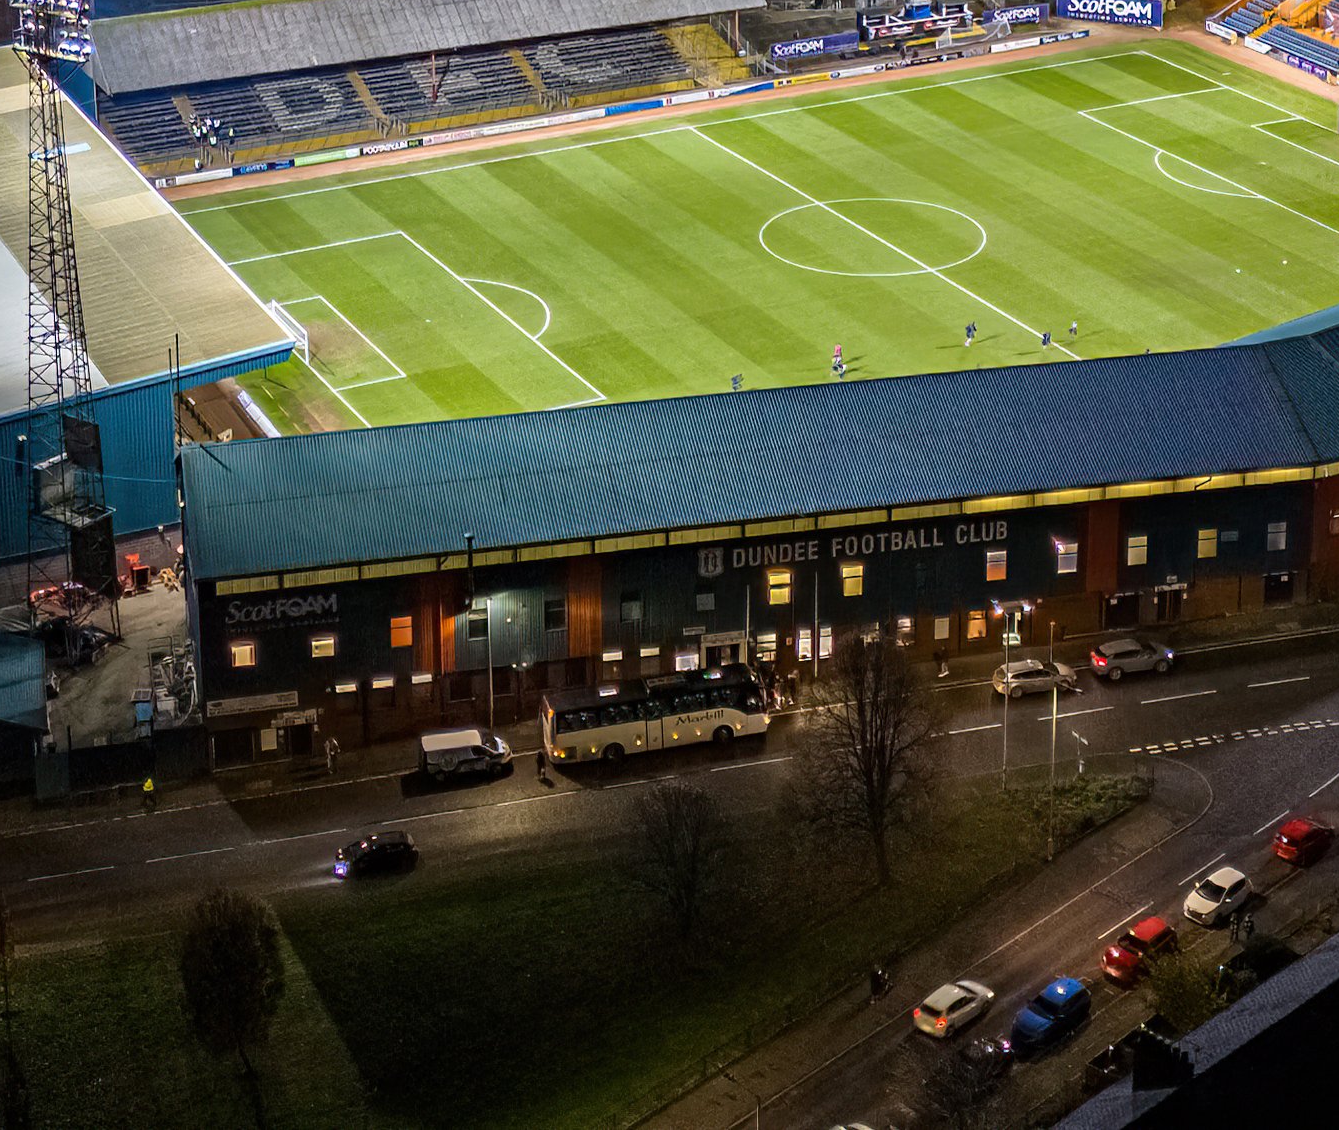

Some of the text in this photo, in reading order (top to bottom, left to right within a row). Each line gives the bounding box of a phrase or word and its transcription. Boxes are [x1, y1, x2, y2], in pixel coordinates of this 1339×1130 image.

[772, 38, 824, 59] ScotFOAM
[732, 520, 1008, 569] DUNDEE FOOTBALL CLUB
[225, 593, 338, 625] ScotFOAM
